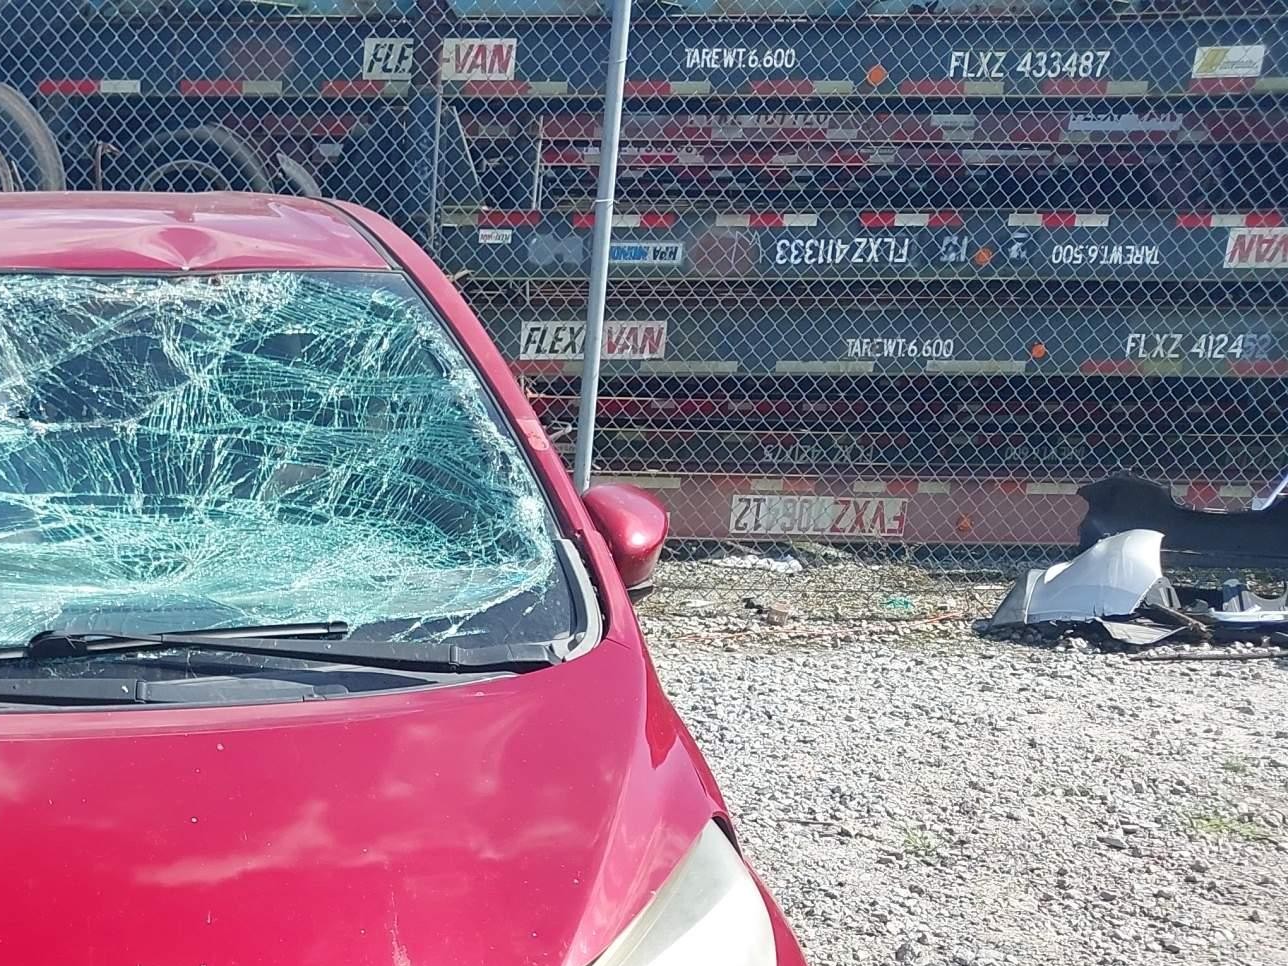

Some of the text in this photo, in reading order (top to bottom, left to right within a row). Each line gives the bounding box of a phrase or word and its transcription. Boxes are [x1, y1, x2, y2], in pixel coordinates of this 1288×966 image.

[948, 50, 1111, 78] FLXZ 433487
[775, 238, 851, 264] 411333
[852, 237, 910, 263] FLXZ
[1124, 333, 1273, 359] FLXZ 412452
[829, 499, 908, 534] FVXZ
